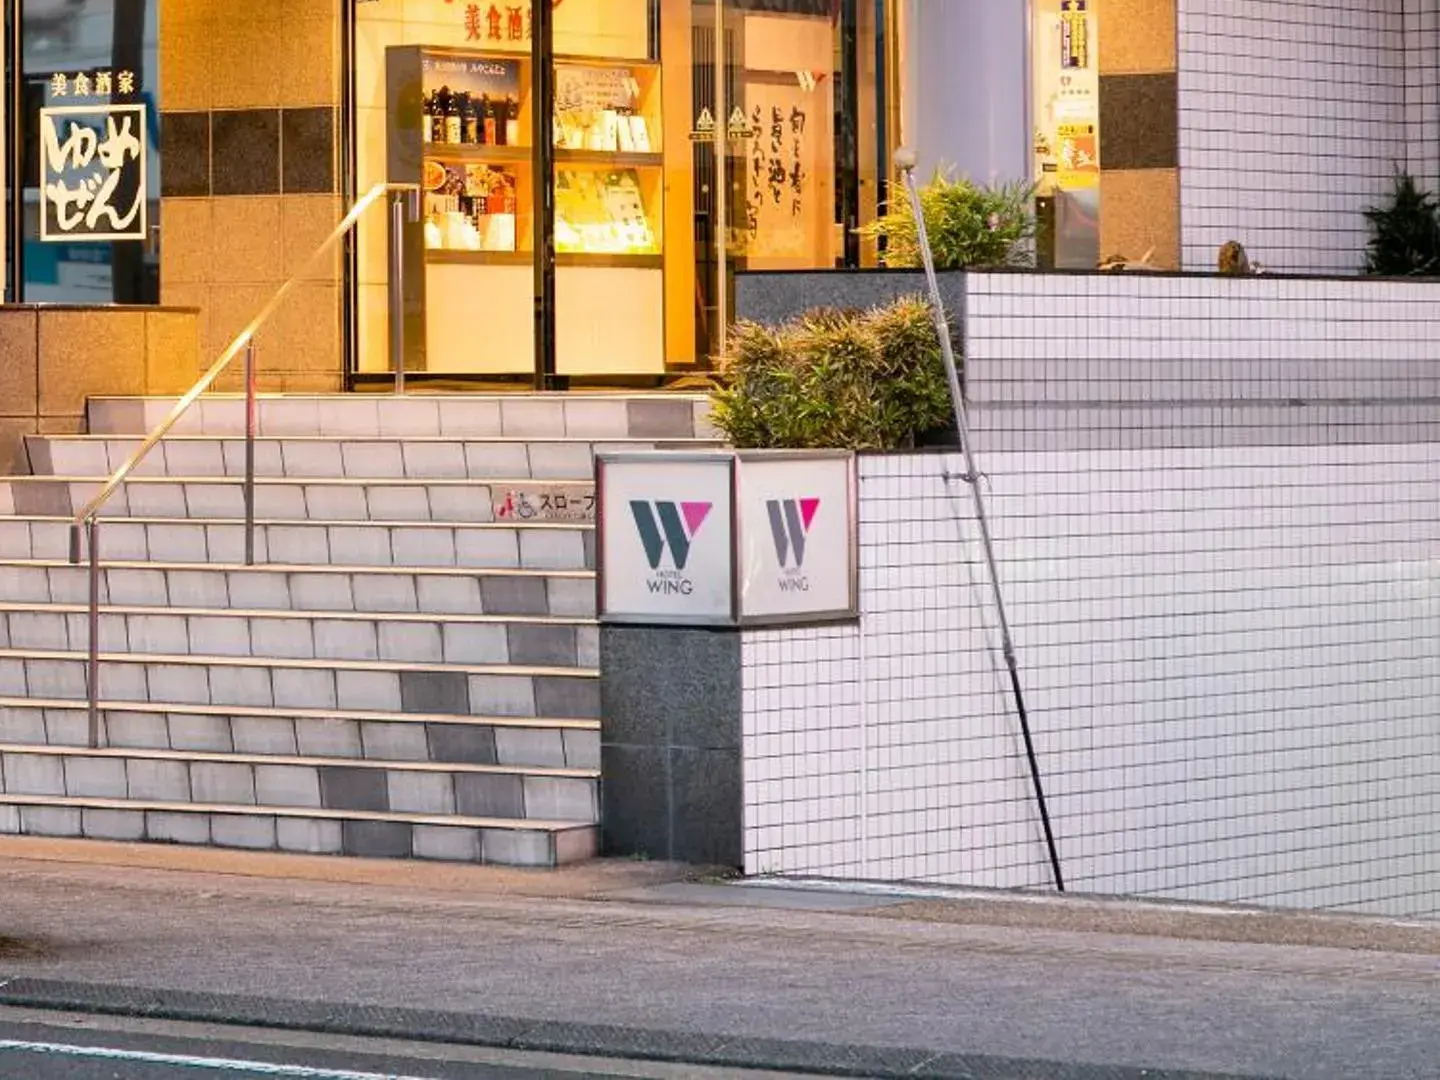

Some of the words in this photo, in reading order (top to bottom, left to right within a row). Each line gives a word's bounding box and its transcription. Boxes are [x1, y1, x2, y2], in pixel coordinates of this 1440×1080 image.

[464, 4, 532, 42] 美食酒
[51, 71, 135, 96] 美食酒家
[647, 578, 694, 596] WING
[777, 576, 810, 593] WING
